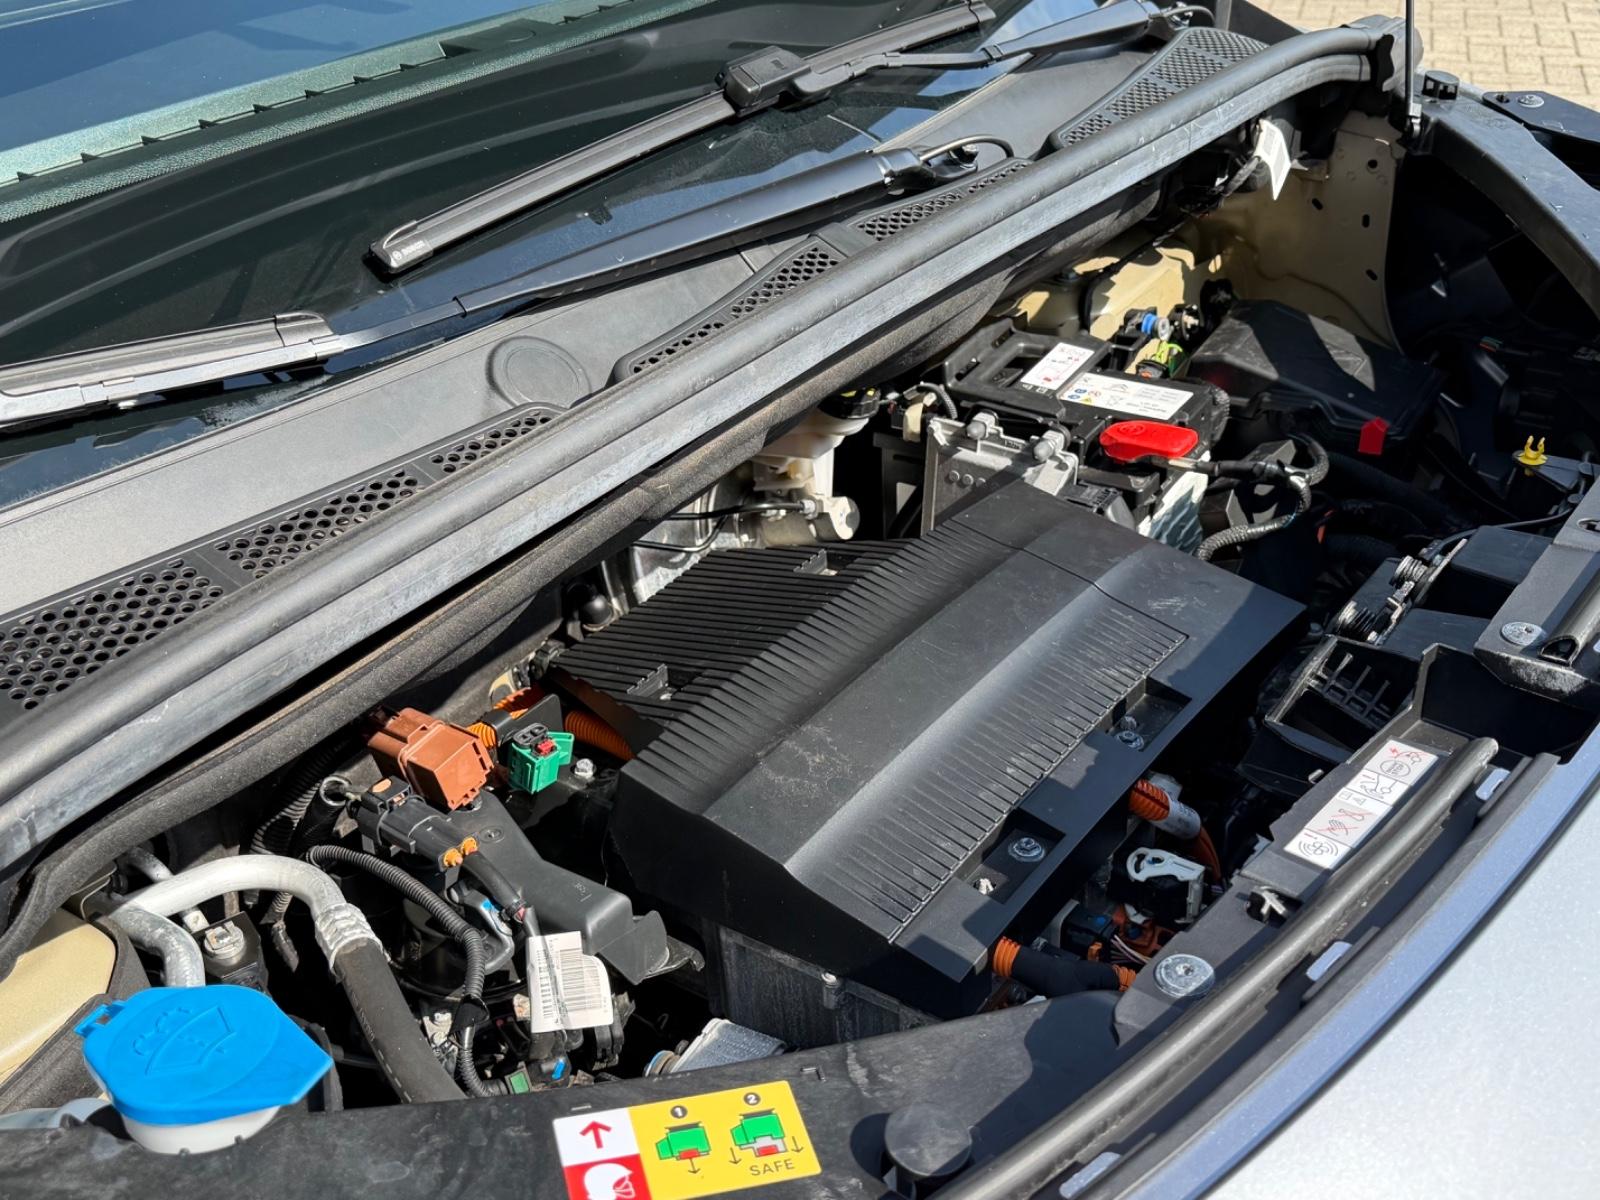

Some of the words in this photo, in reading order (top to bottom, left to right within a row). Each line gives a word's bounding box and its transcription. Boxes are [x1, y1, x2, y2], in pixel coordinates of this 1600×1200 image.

[674, 1107, 683, 1117] 1
[747, 1094, 758, 1105] 2
[750, 1158, 795, 1176] SAFE
